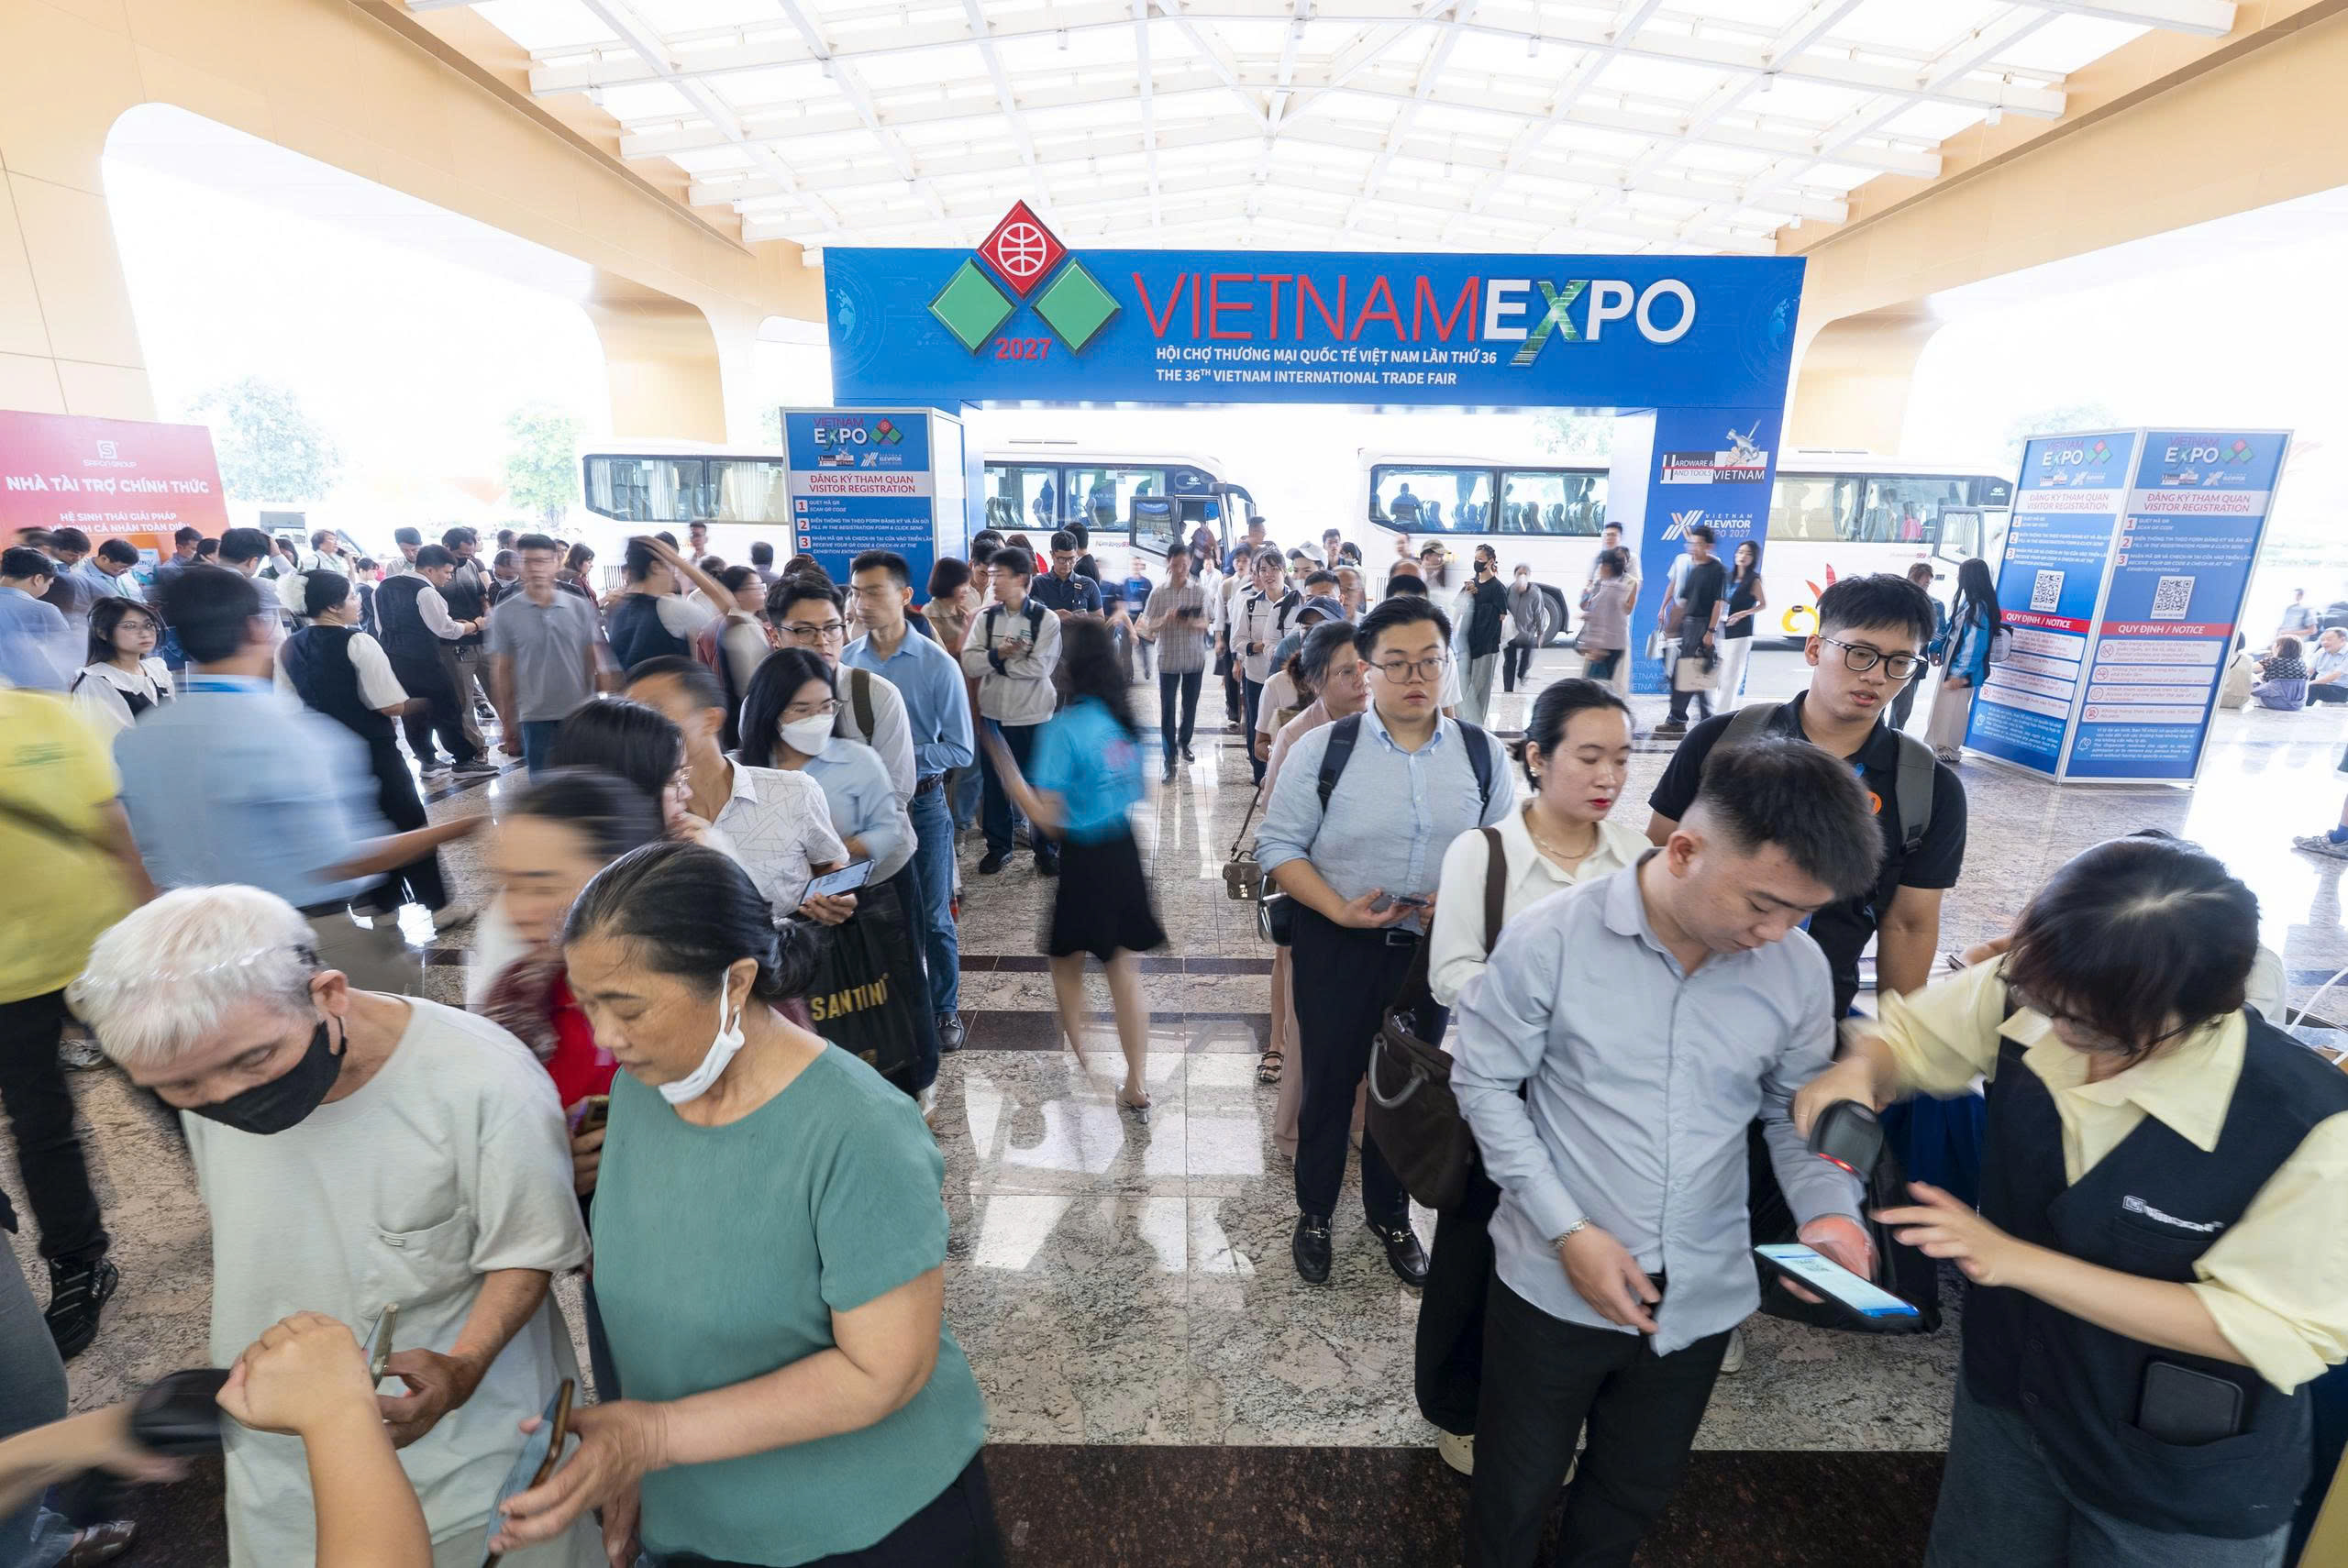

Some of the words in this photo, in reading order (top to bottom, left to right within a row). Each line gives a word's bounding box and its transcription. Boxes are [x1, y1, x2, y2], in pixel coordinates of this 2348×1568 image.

[1132, 272, 1480, 342] VIETNAM
[1483, 278, 1696, 367] EXPO
[995, 337, 1052, 359] 2027
[1156, 345, 1180, 363] HỘI
[1183, 346, 1212, 363] CHỢ
[1213, 346, 1270, 361] THƯƠNG
[1273, 348, 1297, 364] MẠI
[1300, 346, 1338, 364] QUỐC
[1341, 347, 1357, 362] TẾ
[1359, 348, 1388, 366] VIỆT
[1390, 351, 1419, 362] NAM
[1423, 347, 1448, 363] LẦN
[1451, 348, 1480, 363] THỨ
[1481, 351, 1497, 363] 36
[1156, 370, 1181, 381] THE
[1213, 370, 1271, 382] VIETNAM
[1274, 370, 1379, 383] INTERNATIONAL
[1381, 371, 1424, 383] TRADE
[1427, 372, 1456, 384] FAIR
[814, 417, 864, 426] VIETNAM
[814, 428, 868, 448] EXPO
[2042, 449, 2084, 467] EXPO
[2165, 447, 2220, 467] EXPO
[810, 474, 837, 483] ĐĂNG
[840, 473, 853, 482] KÝ
[885, 476, 914, 484] QUAN
[1712, 469, 1765, 480] VIETNAM
[6, 474, 49, 491] NHÀ
[50, 474, 81, 492] TÀI
[82, 476, 117, 495] TRỢ
[120, 477, 169, 493] CHÍNH
[171, 476, 209, 493] THỨC
[848, 485, 915, 493] REGISTRATION
[2085, 492, 2110, 502] QUAN
[2147, 491, 2176, 502] ĐĂNG
[2176, 491, 2191, 502] KÝ
[2192, 493, 2221, 502] THAM
[2221, 494, 2251, 503] QUAN
[799, 502, 805, 511] 1
[2055, 502, 2109, 510] REGISTRATION
[2143, 503, 2181, 512] VISITOR
[2183, 503, 2250, 513] REGISTRATION
[76, 513, 102, 522] SINH
[104, 512, 128, 521] THÁI
[800, 520, 807, 529] 2
[2127, 519, 2133, 529] 1
[1729, 529, 1751, 538] 2027
[801, 537, 808, 547] 3
[2122, 537, 2130, 547] 2
[2118, 555, 2125, 564] 3
[2006, 613, 2022, 622] QUY
[2021, 614, 2041, 625] ĐỊNH
[2046, 618, 2072, 629] NOTICE
[2118, 624, 2139, 634] QUY
[2140, 625, 2164, 635] ĐỊNH
[2165, 625, 2171, 634] /
[2171, 625, 2205, 635] NOTICE
[810, 977, 888, 1021] SANTINI
